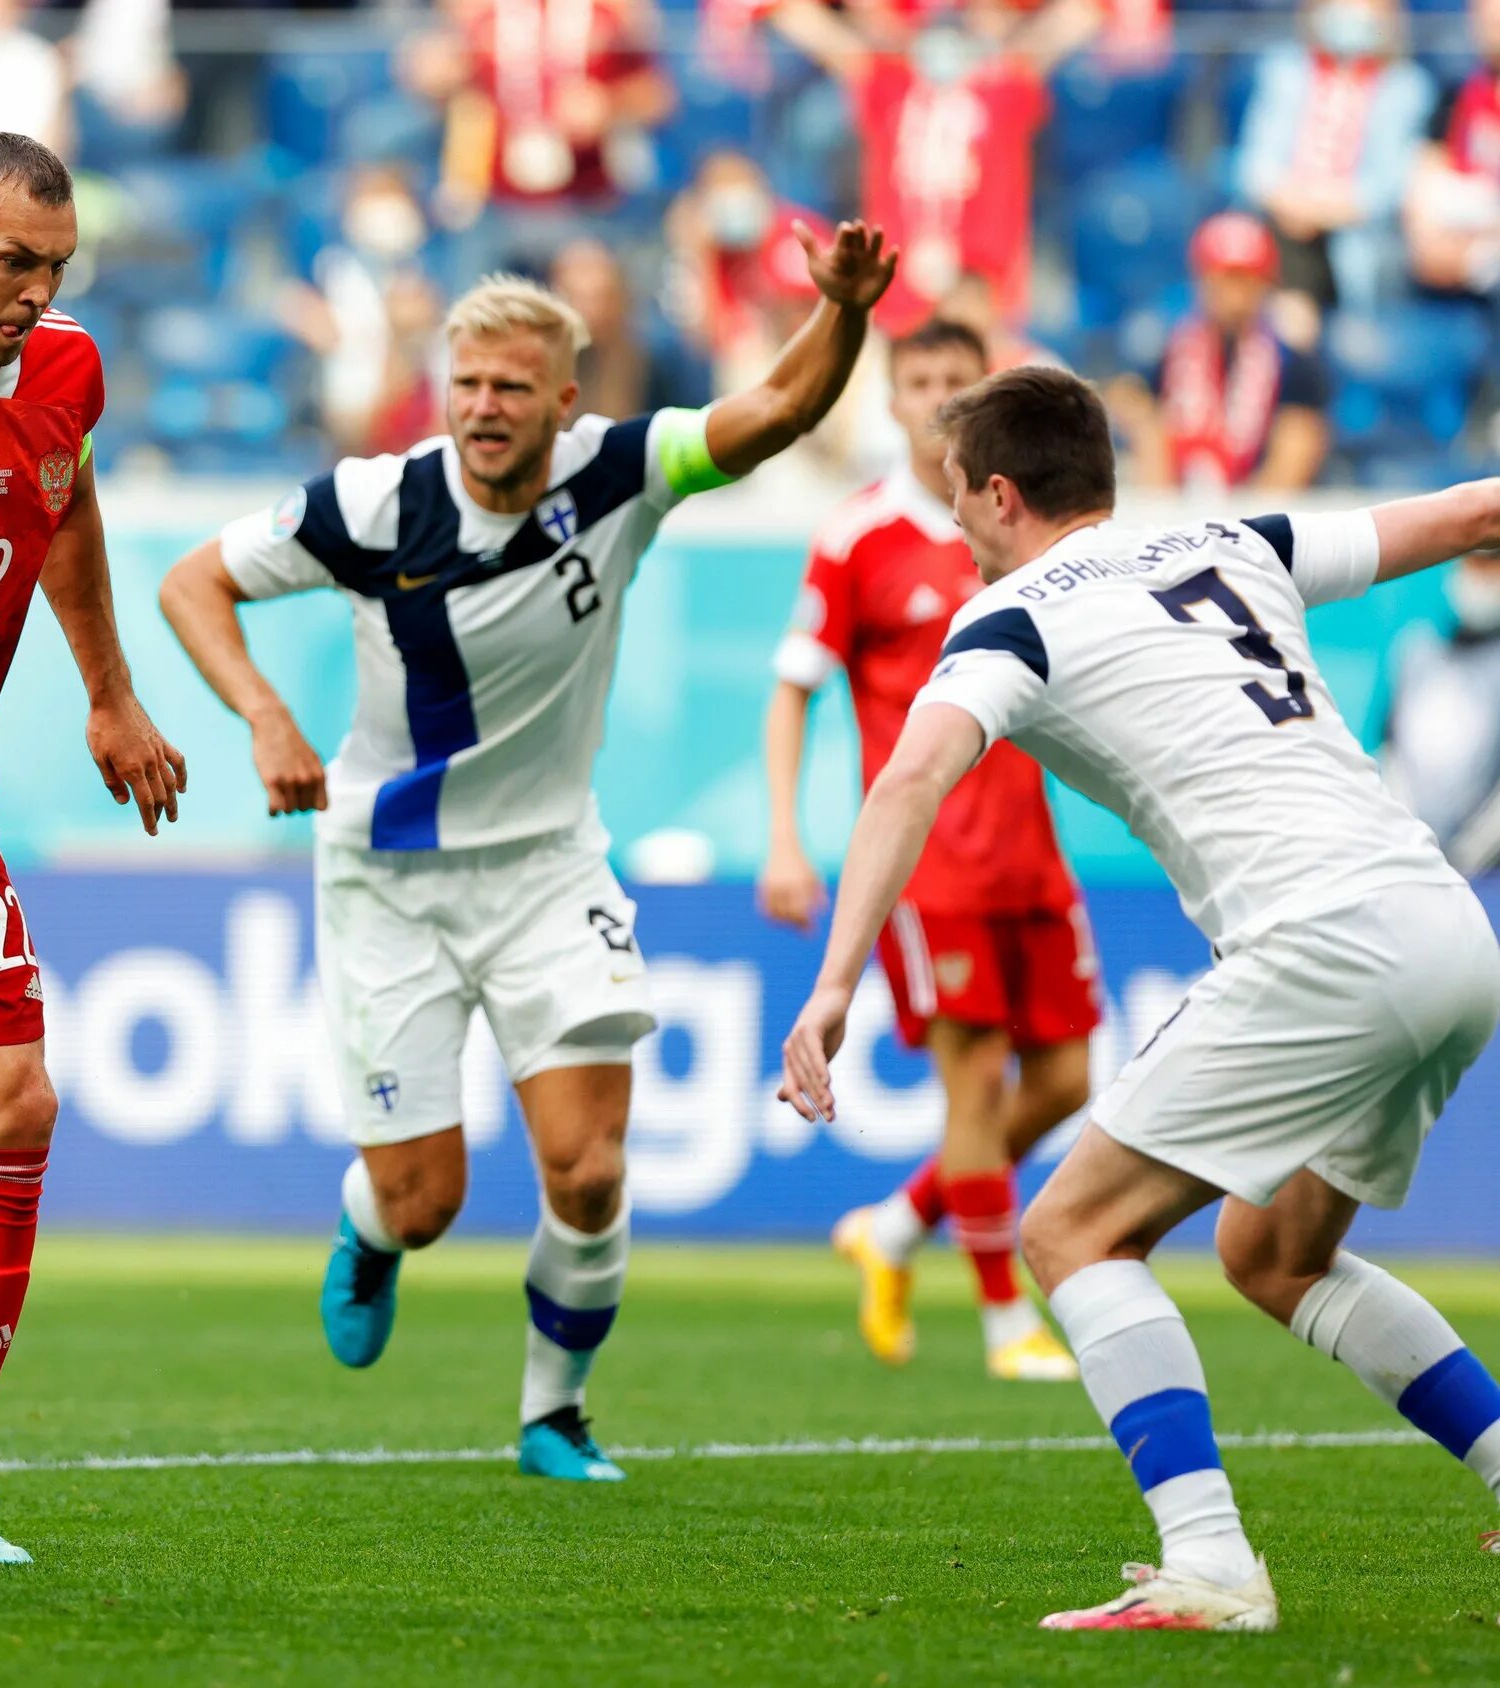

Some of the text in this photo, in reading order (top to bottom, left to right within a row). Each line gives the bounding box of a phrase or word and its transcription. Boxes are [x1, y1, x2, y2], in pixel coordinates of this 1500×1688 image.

[555, 553, 601, 622] 2
[1149, 566, 1315, 727] 3
[588, 908, 632, 952] 2
